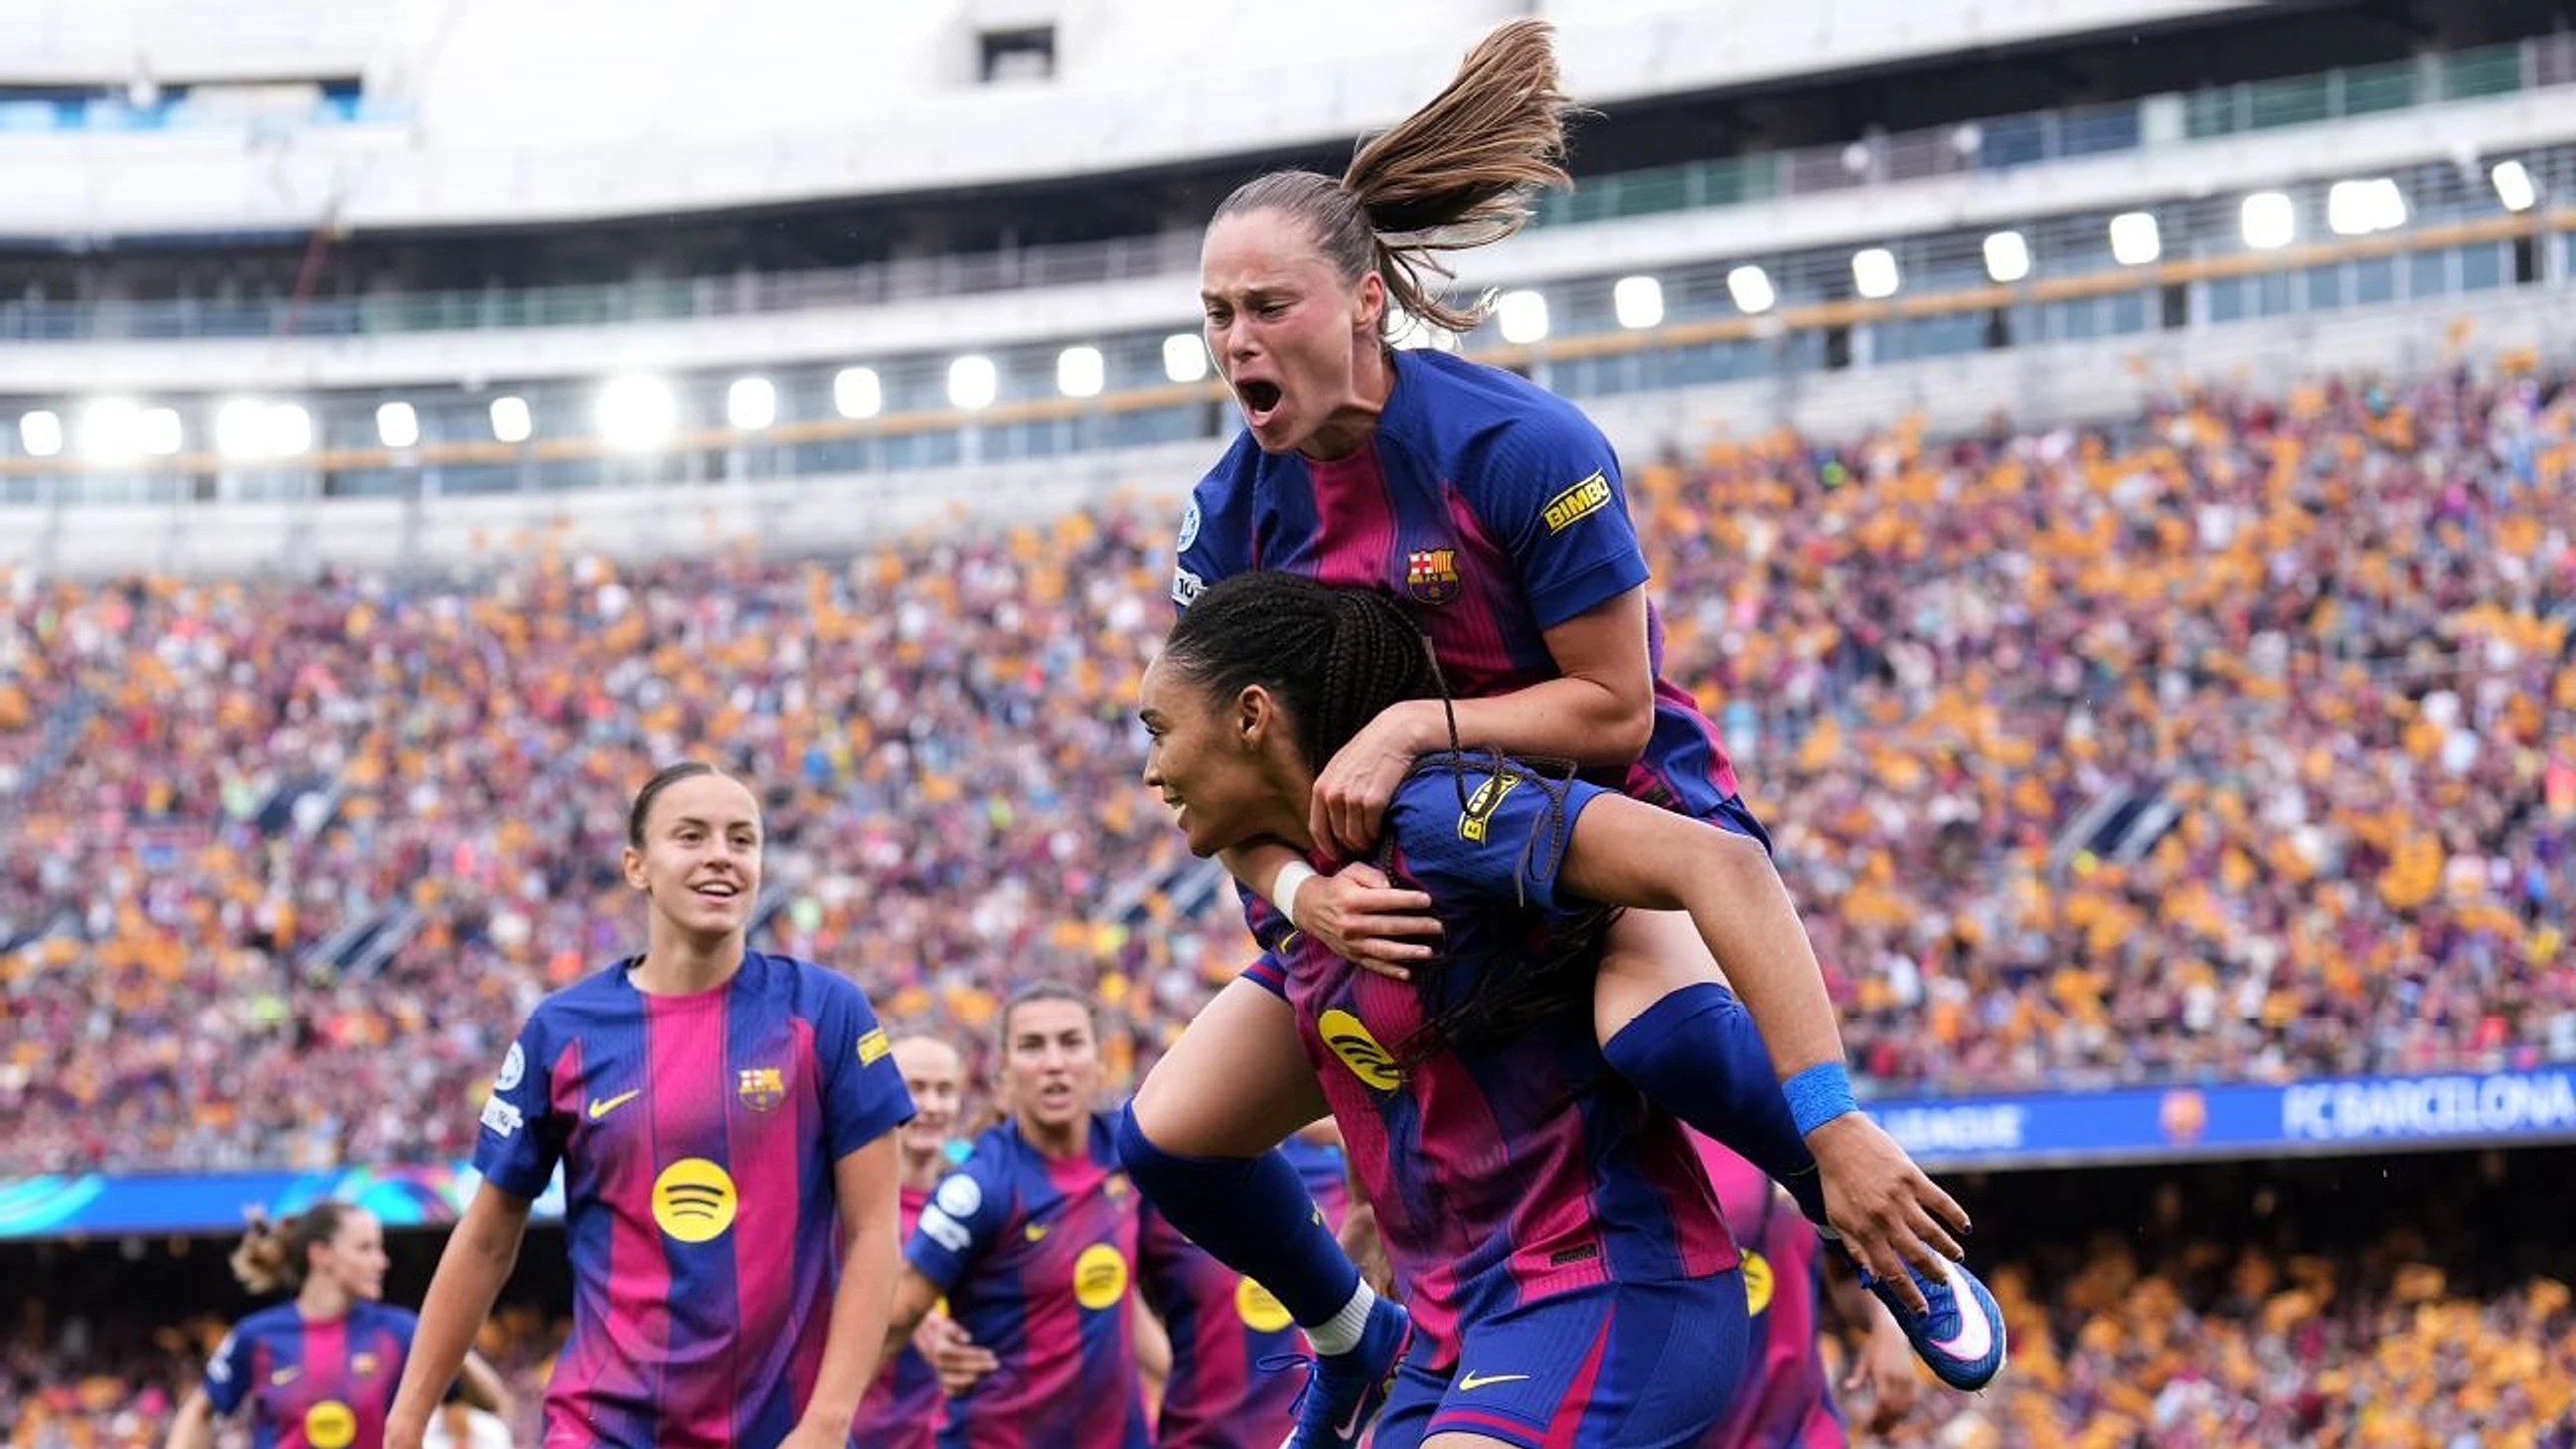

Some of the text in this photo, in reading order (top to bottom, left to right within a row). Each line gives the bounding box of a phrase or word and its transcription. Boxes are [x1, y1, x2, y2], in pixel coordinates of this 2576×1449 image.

[1543, 474, 1610, 531] BIMBO
[2282, 1071, 2576, 1139] FC BARCELONA
